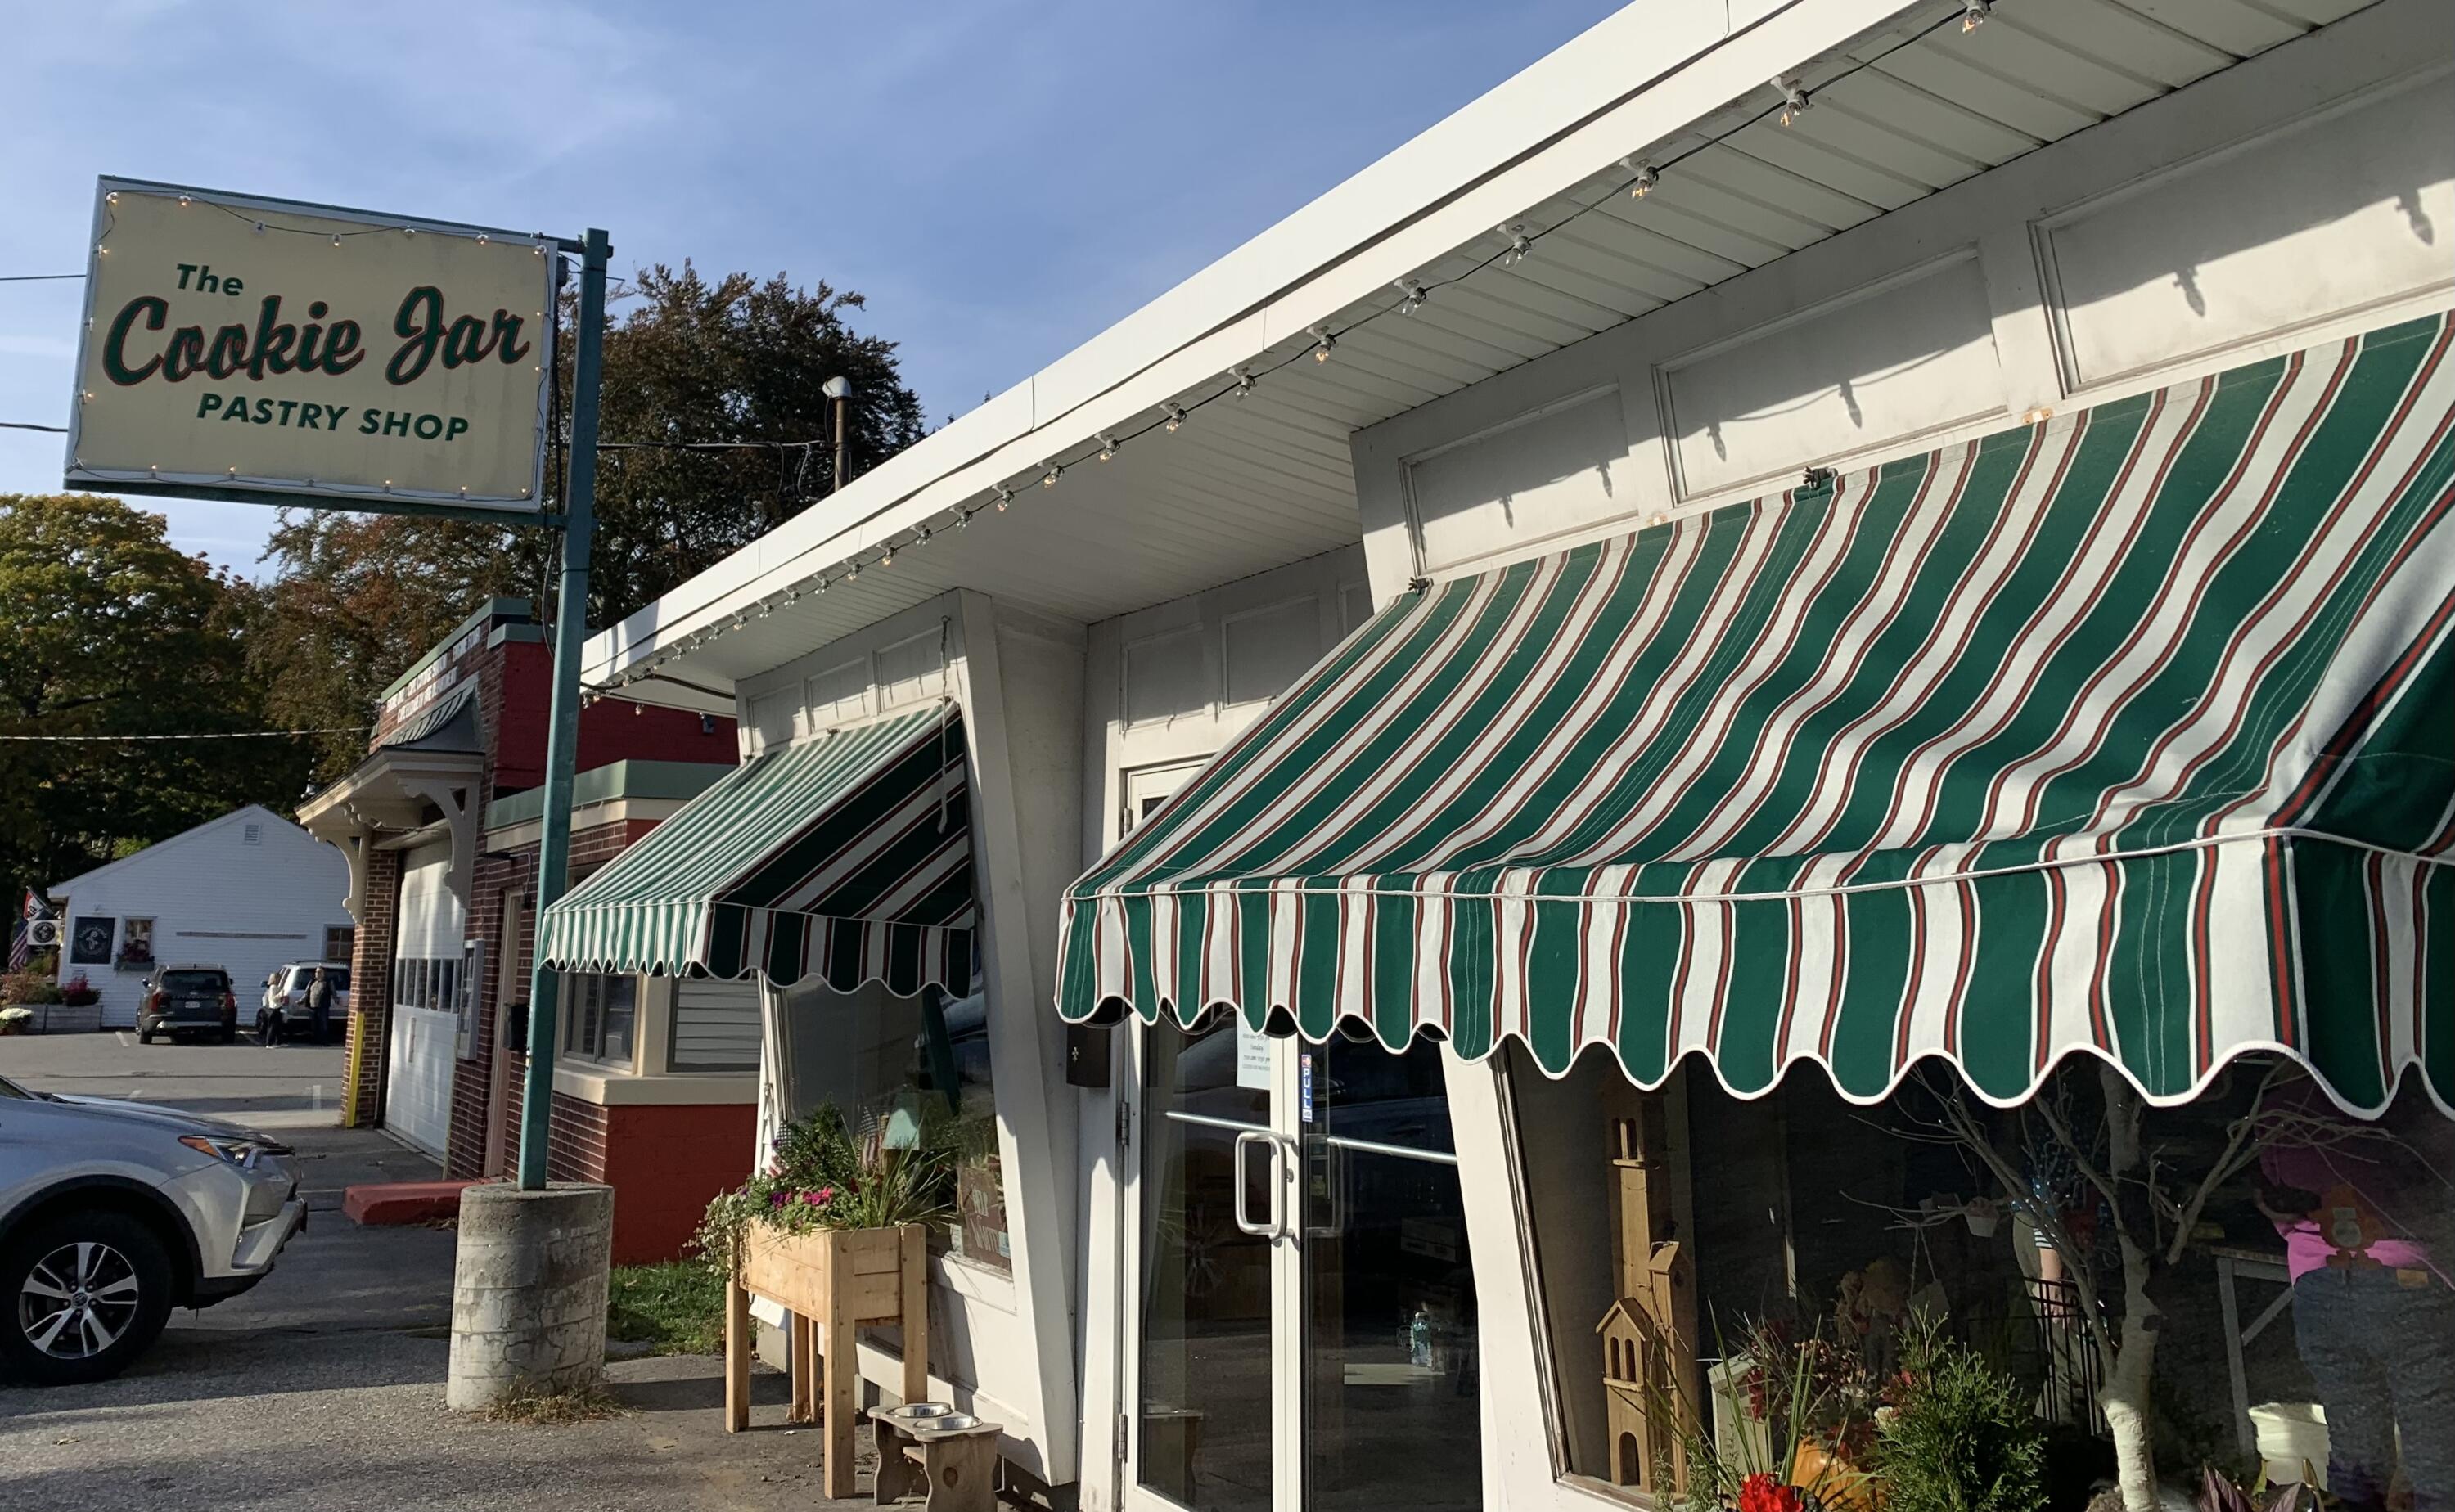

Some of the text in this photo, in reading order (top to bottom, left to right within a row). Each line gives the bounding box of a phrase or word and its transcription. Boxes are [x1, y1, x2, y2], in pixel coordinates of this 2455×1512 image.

[176, 263, 244, 297] The
[102, 285, 531, 387] Cookie Jar
[196, 392, 470, 443] PASTRY SHOP
[1303, 1067, 1312, 1109] PULL
